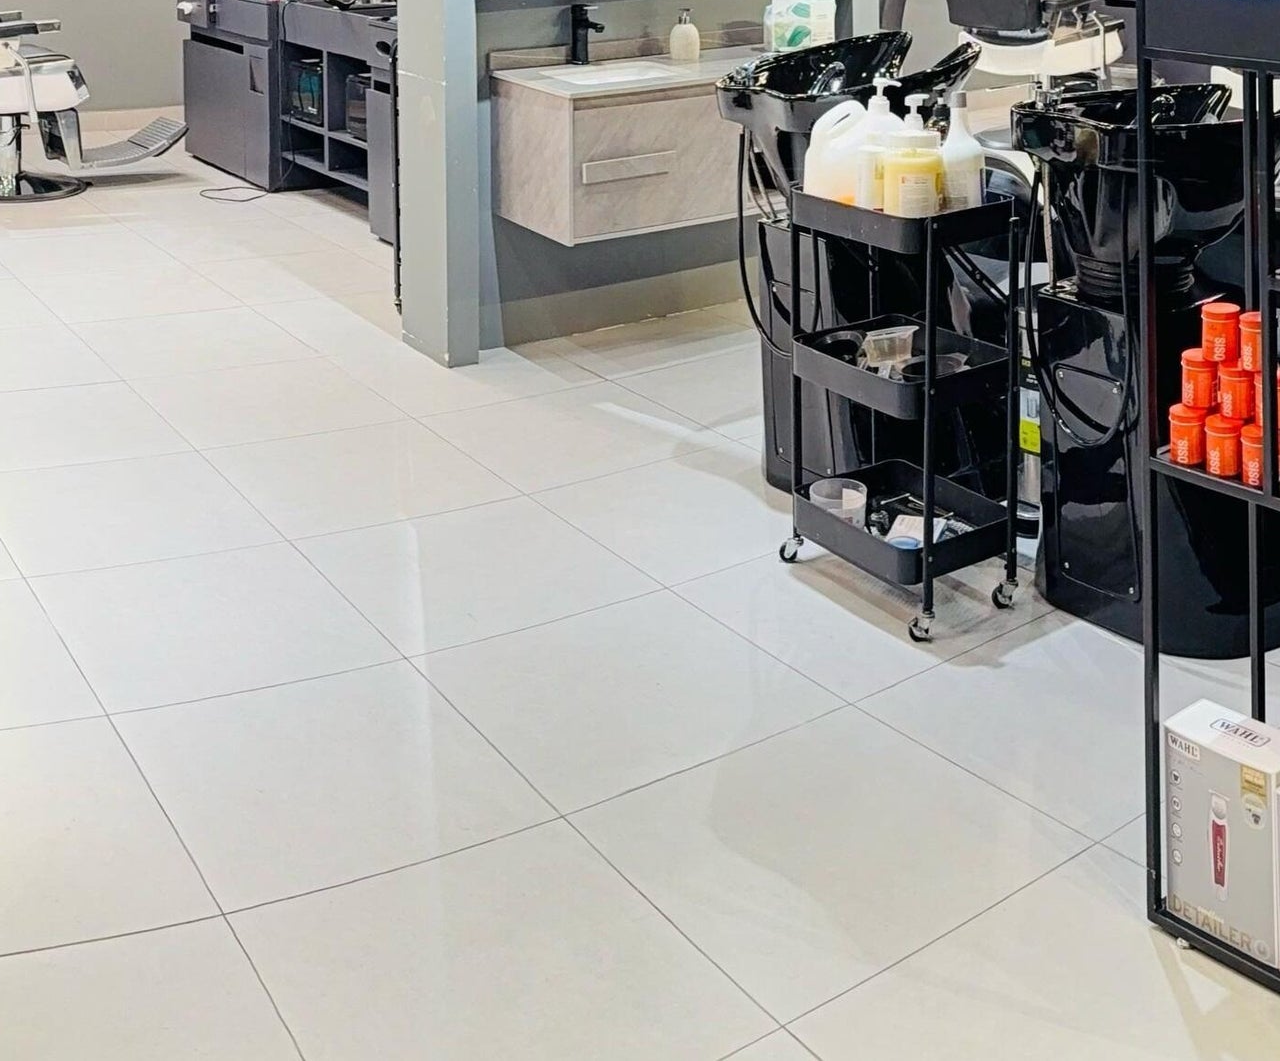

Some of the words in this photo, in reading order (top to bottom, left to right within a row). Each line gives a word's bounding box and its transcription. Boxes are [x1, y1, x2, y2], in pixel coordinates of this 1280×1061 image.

[1219, 720, 1263, 745] WAHL
[1170, 737, 1199, 758] WAHL
[1173, 894, 1252, 952] DETAILER
